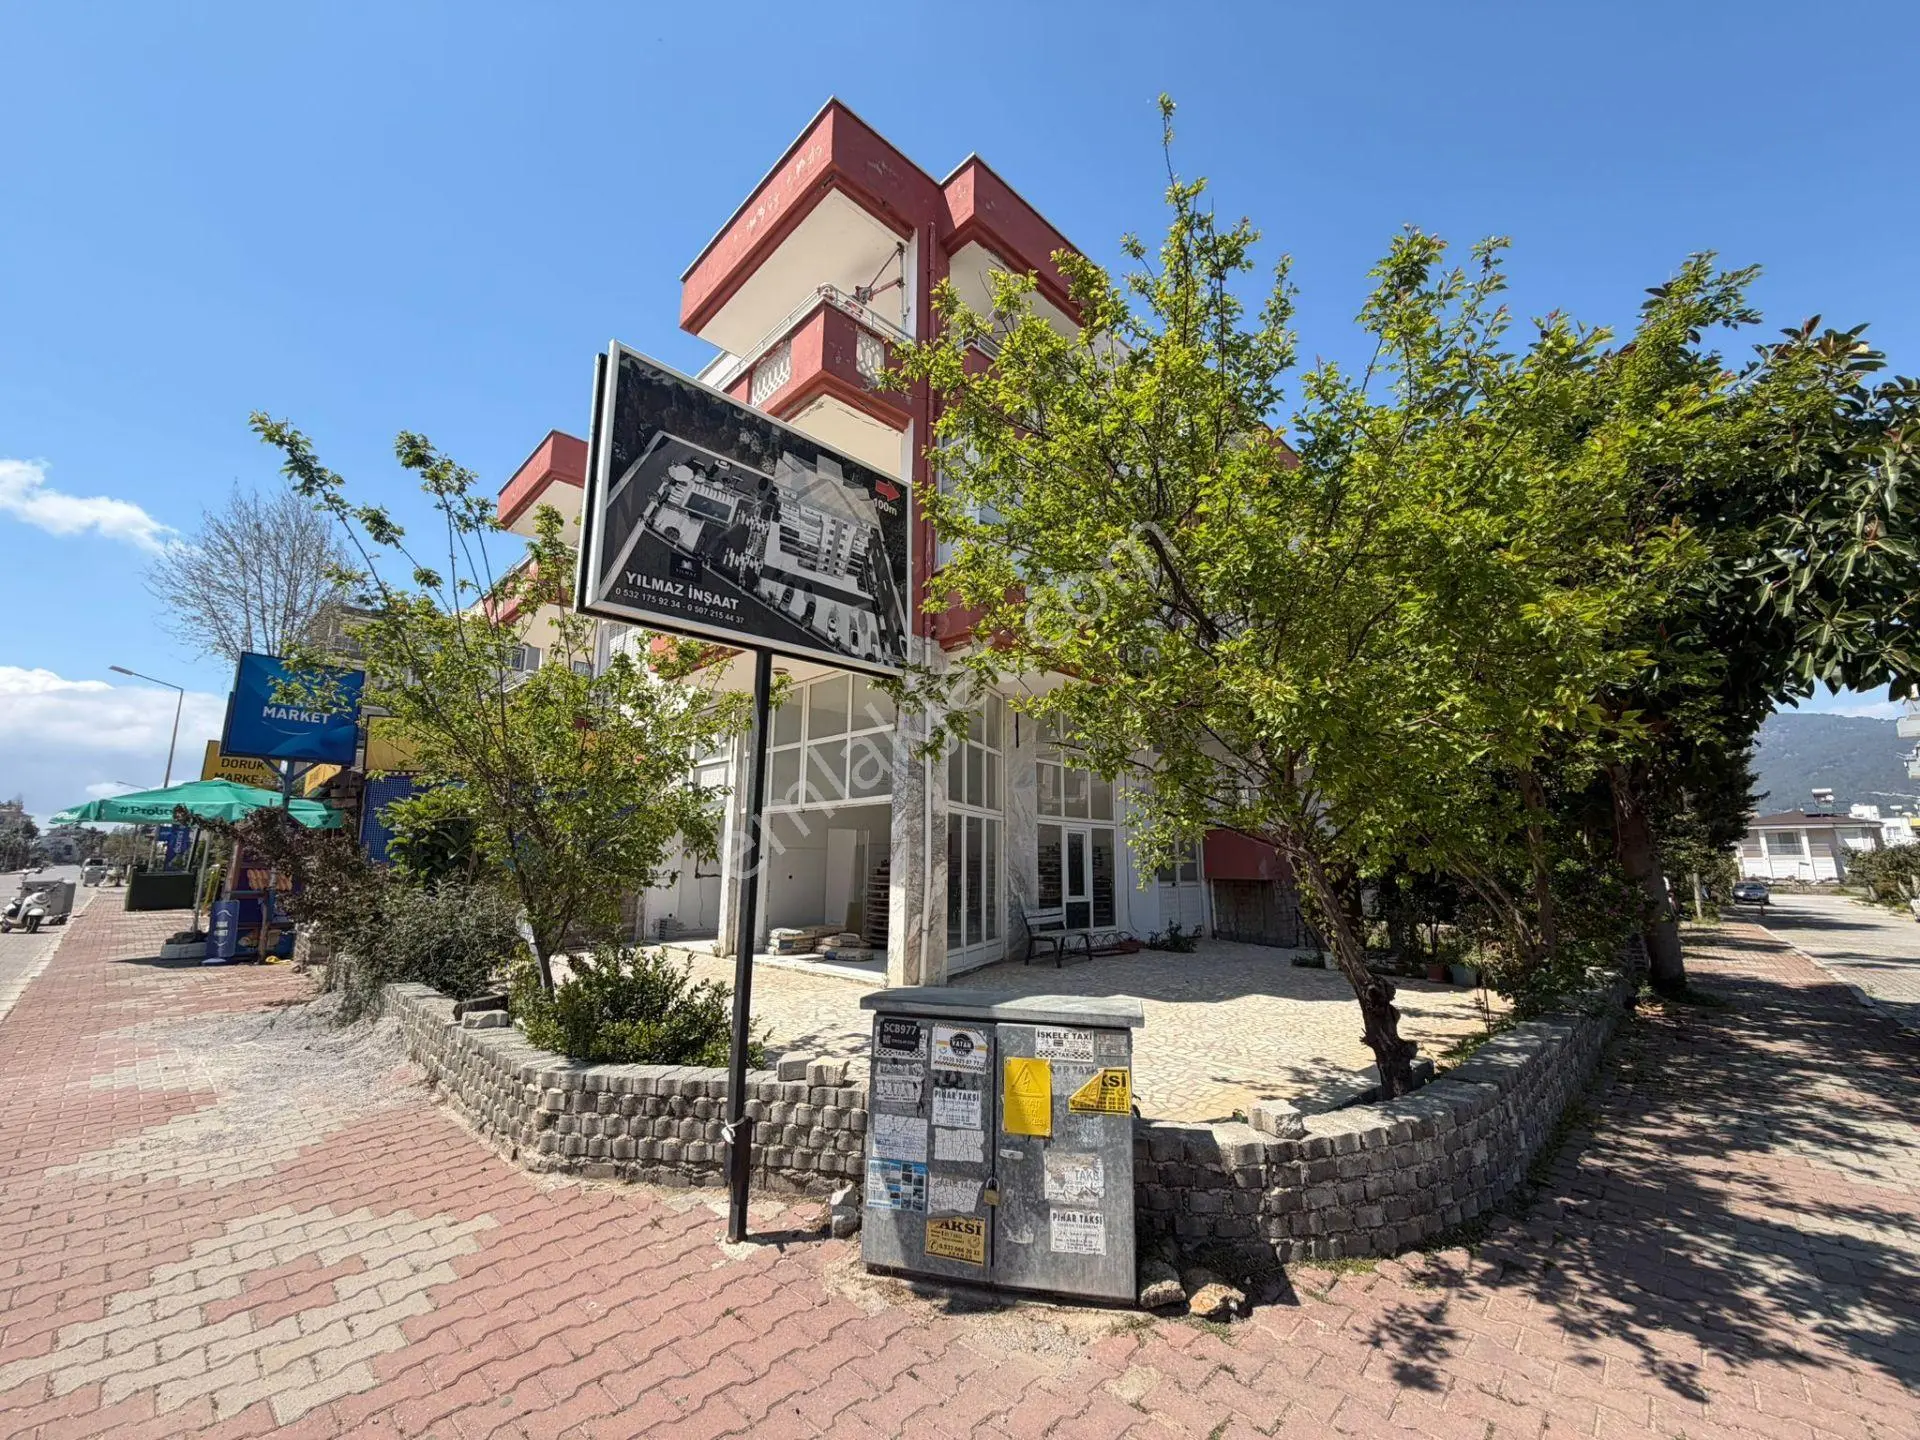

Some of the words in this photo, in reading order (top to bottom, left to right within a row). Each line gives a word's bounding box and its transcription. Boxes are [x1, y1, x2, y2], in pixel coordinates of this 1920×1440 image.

[874, 498, 898, 516] 100m
[625, 570, 684, 597] YILMAZ
[688, 584, 739, 610] İNŞAAT
[615, 587, 621, 595] 0
[623, 588, 640, 600] 532
[658, 596, 669, 606] 92
[670, 599, 681, 609] 34
[687, 604, 693, 612] 0
[709, 609, 723, 620] 215
[262, 706, 331, 725] MARKET
[221, 757, 265, 770] DORUK
[214, 772, 264, 784] MARKE
[1101, 1072, 1126, 1088] KSİ
[937, 1219, 982, 1236] AKSİ
